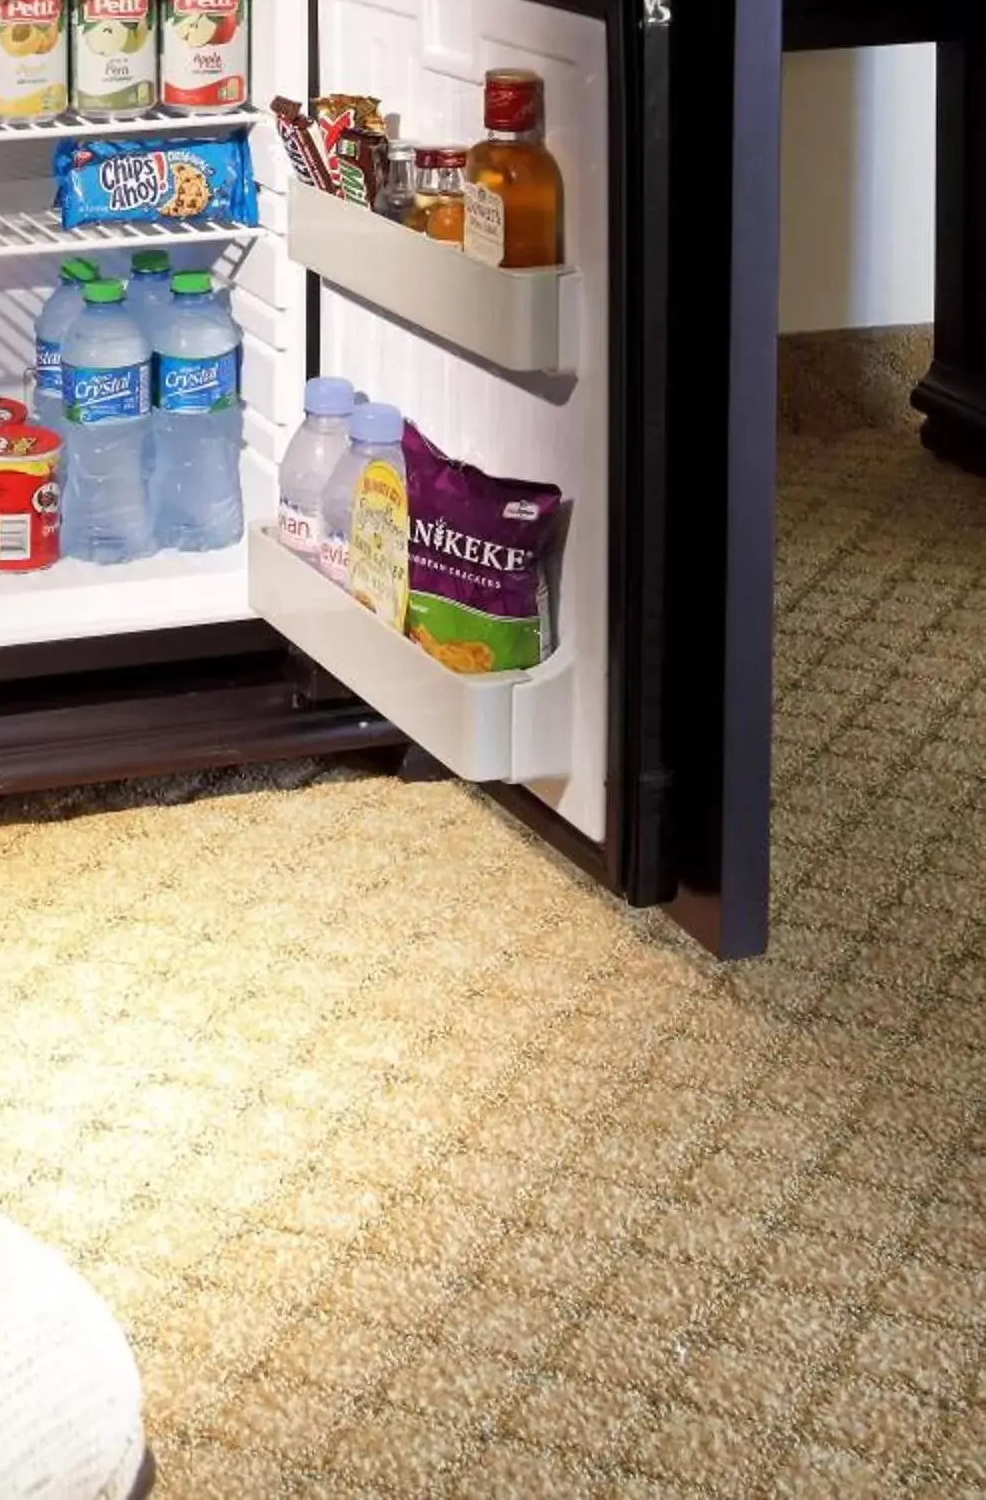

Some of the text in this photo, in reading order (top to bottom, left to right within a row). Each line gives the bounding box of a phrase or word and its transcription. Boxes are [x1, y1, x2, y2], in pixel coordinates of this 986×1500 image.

[101, 155, 156, 191] Chips
[75, 371, 132, 399] Crystal
[166, 362, 219, 388] Crystal
